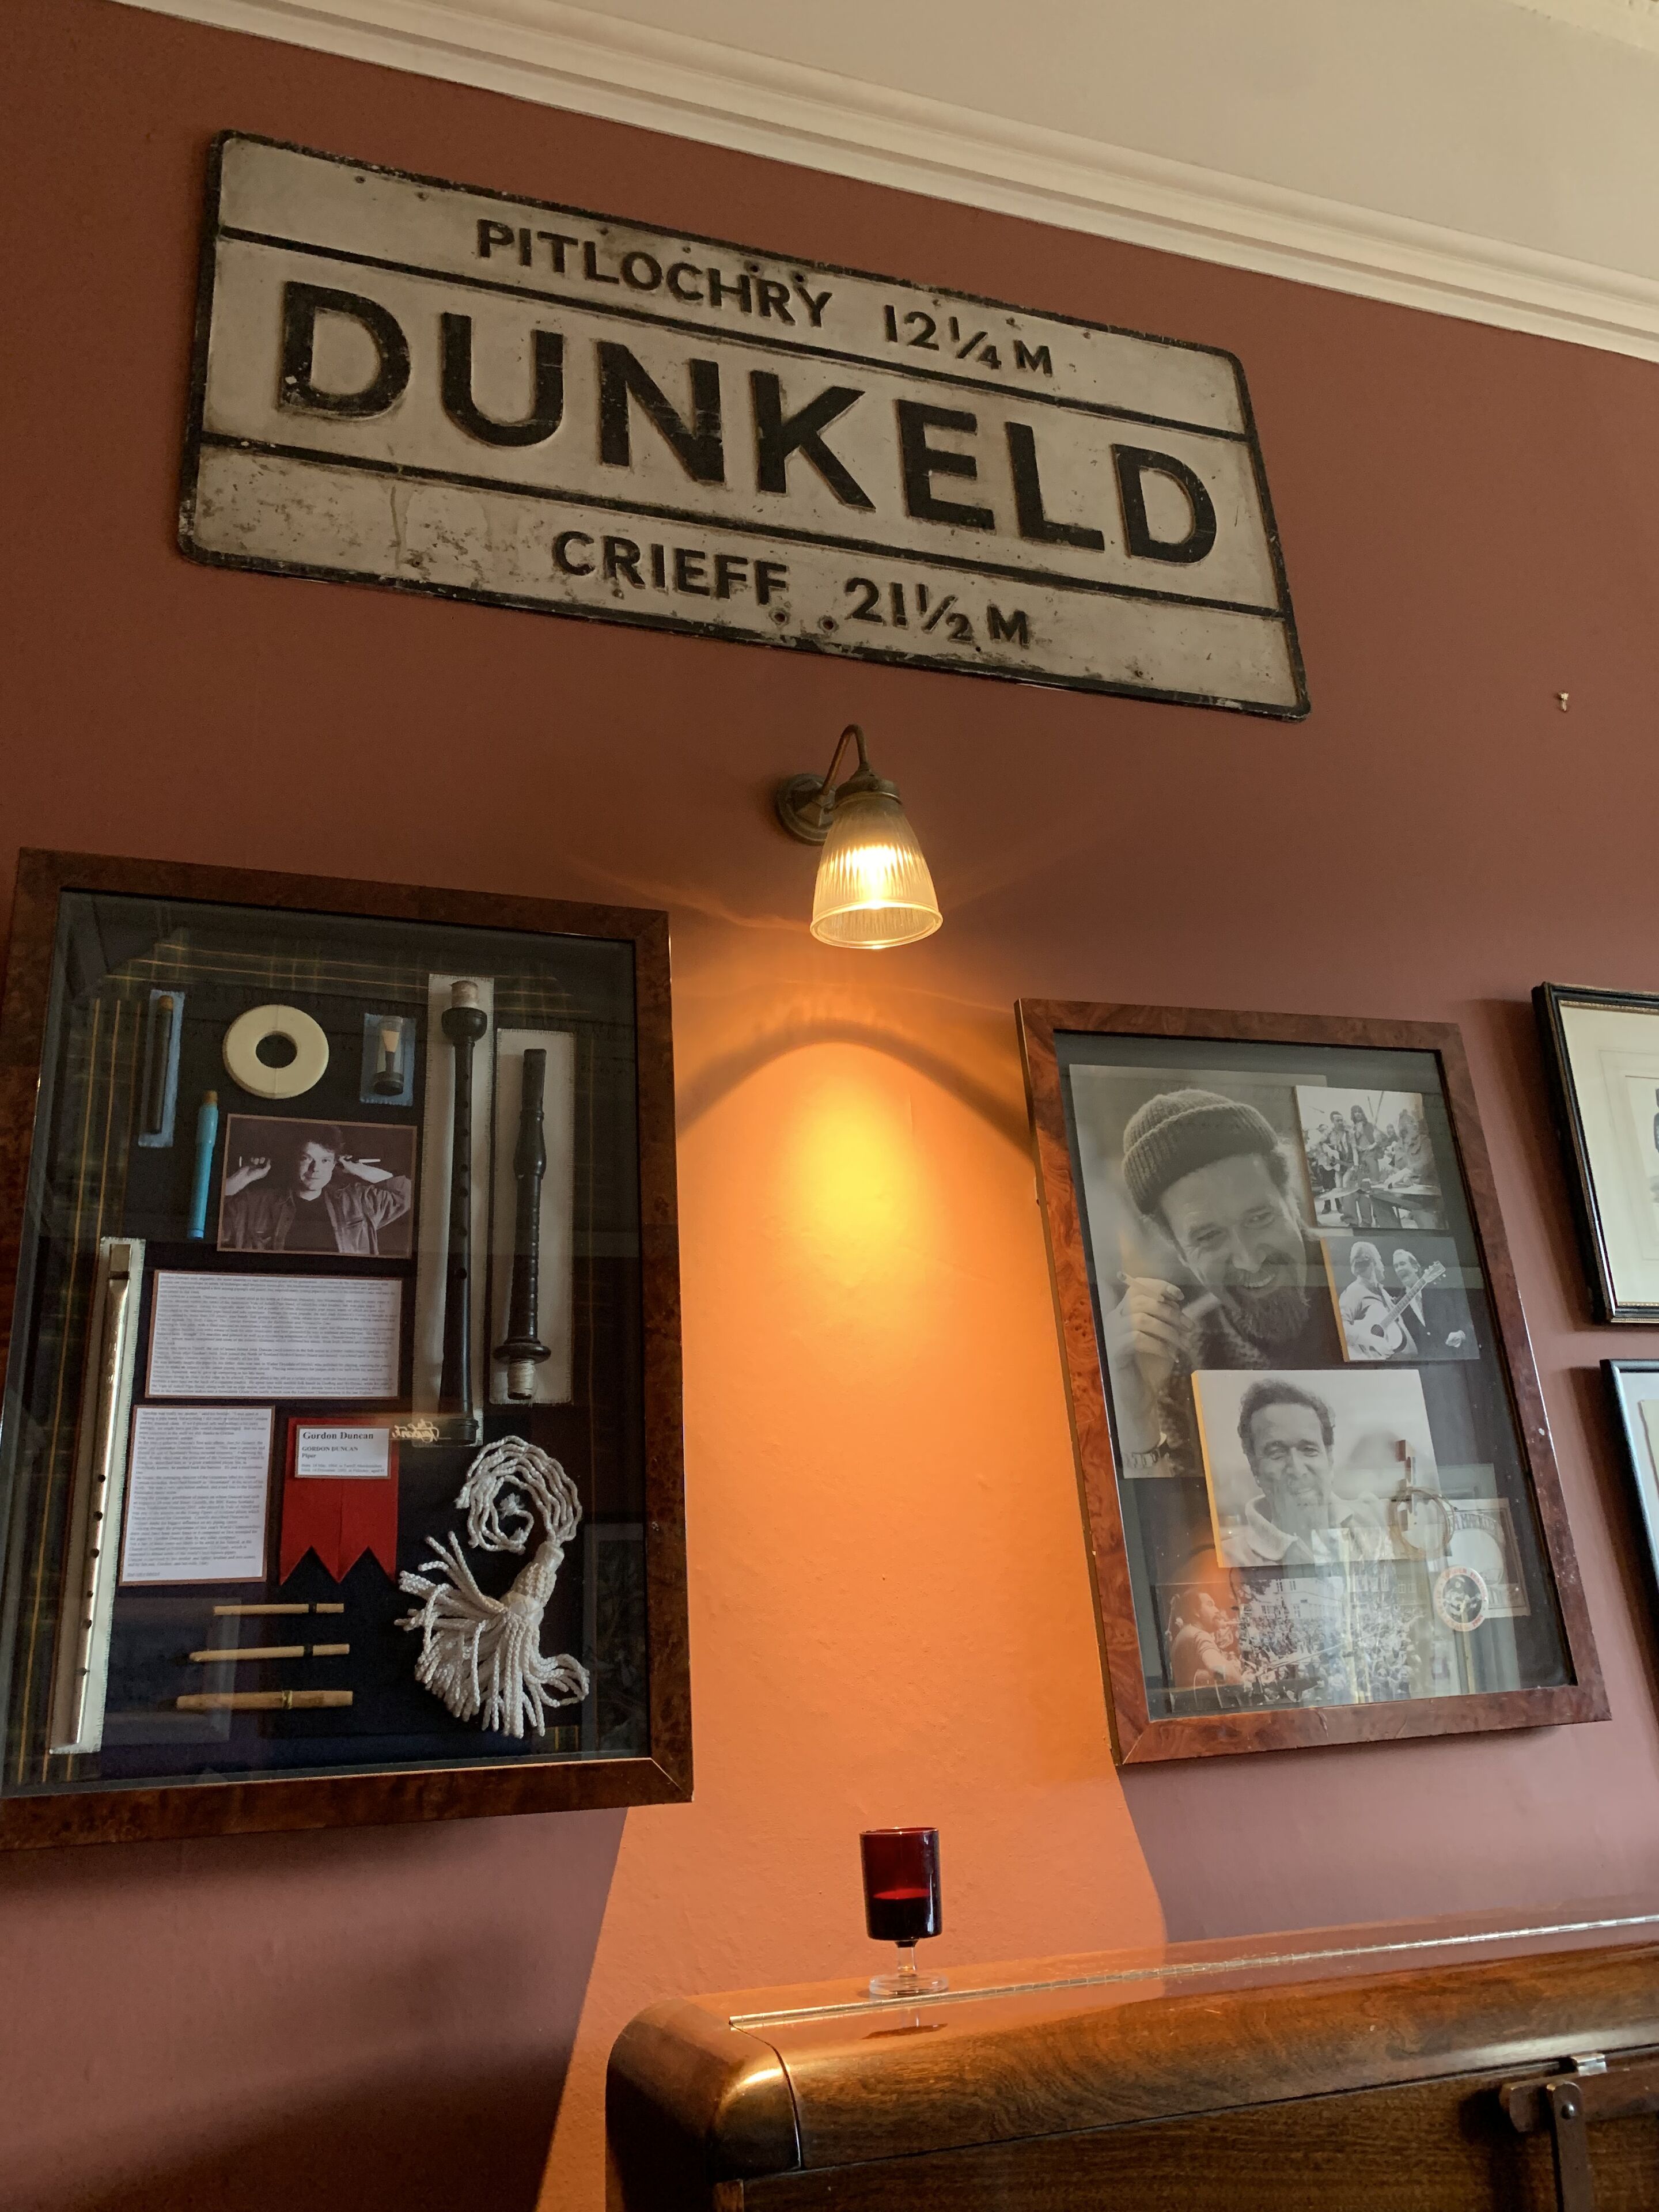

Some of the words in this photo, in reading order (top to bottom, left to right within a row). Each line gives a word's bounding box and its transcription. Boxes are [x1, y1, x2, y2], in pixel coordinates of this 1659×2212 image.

[476, 218, 833, 328] PITLOCHRY
[1013, 339, 1053, 377] M
[279, 280, 1218, 566] DUNKELD
[552, 531, 788, 606] CRIEFF
[986, 603, 1032, 649] M
[302, 1431, 337, 1440] Gordon
[340, 1431, 374, 1440] Duncan
